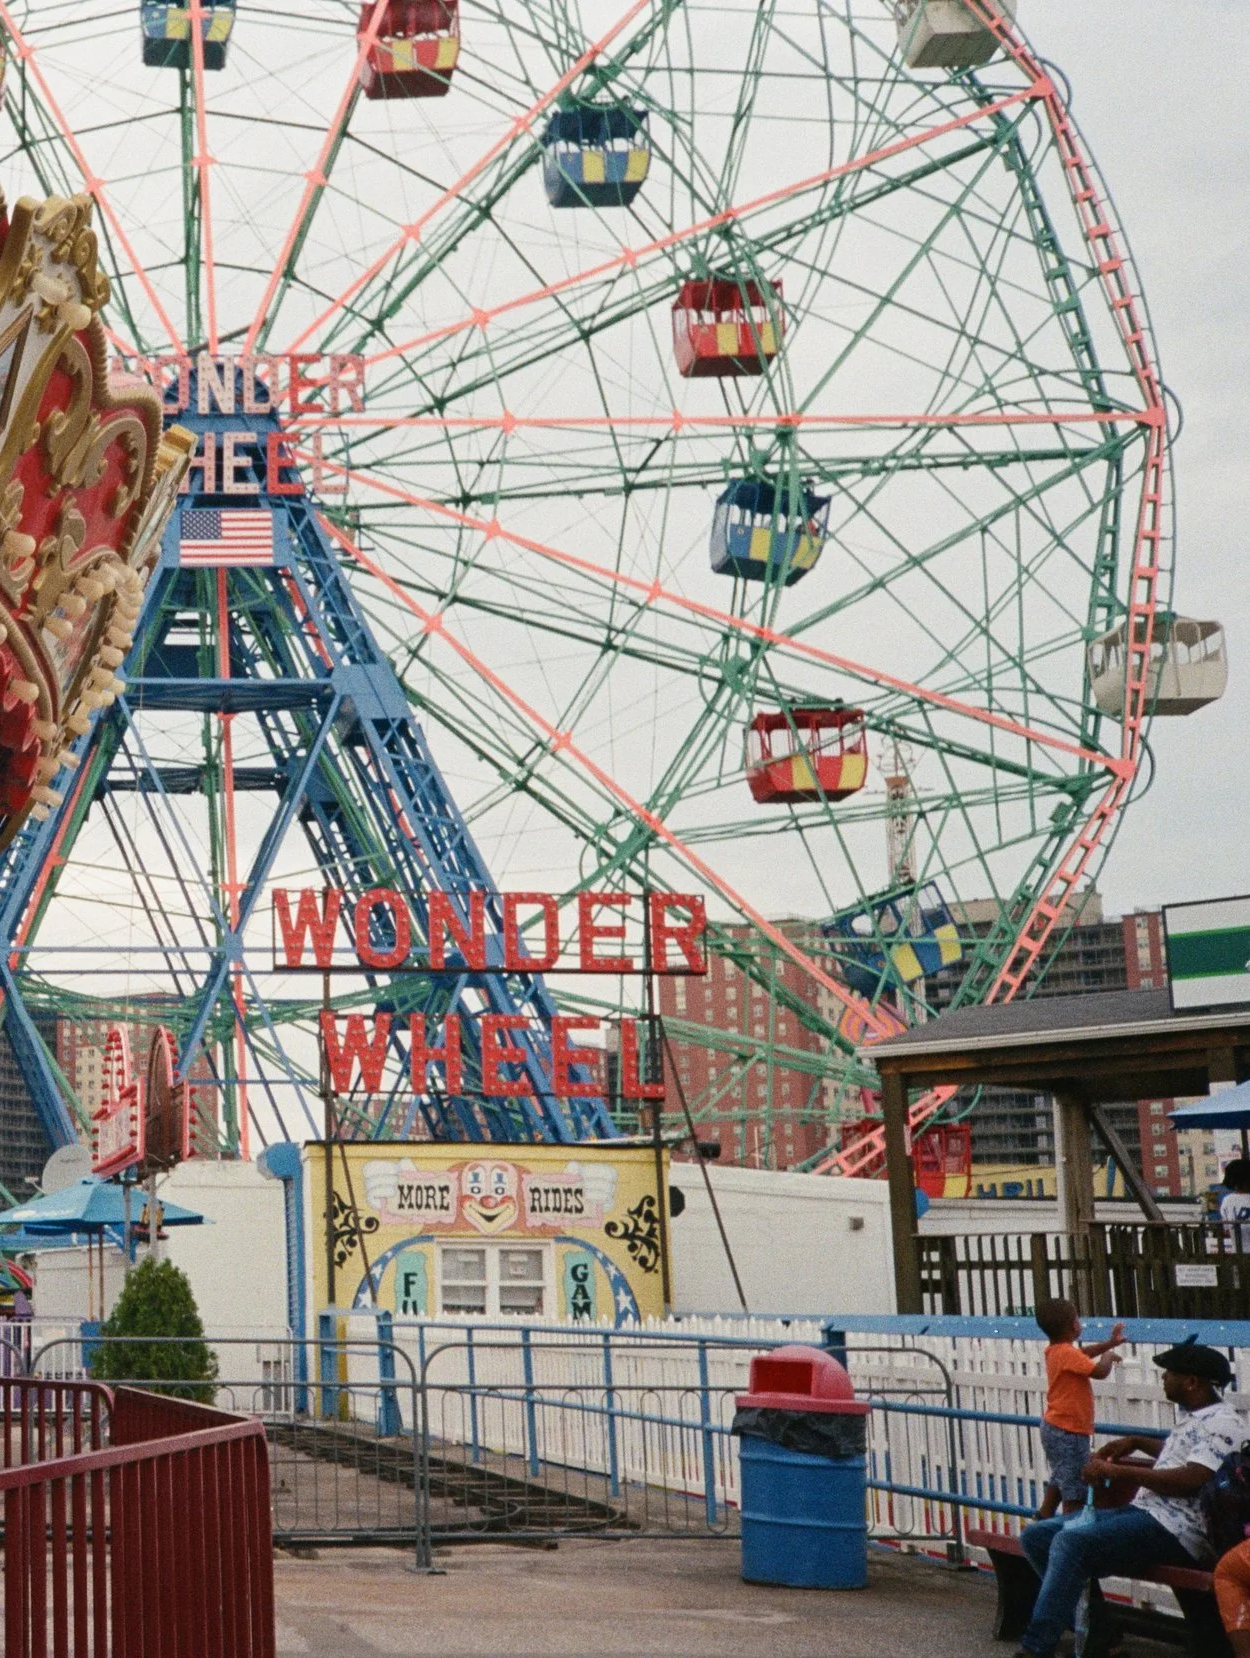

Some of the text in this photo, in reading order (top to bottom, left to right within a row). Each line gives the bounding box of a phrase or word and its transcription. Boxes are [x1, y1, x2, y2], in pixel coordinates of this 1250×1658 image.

[177, 431, 348, 494] HEEL
[272, 888, 707, 972] WONDER
[320, 1010, 665, 1095] WHEEL
[397, 1184, 585, 1214] MORE RIDES
